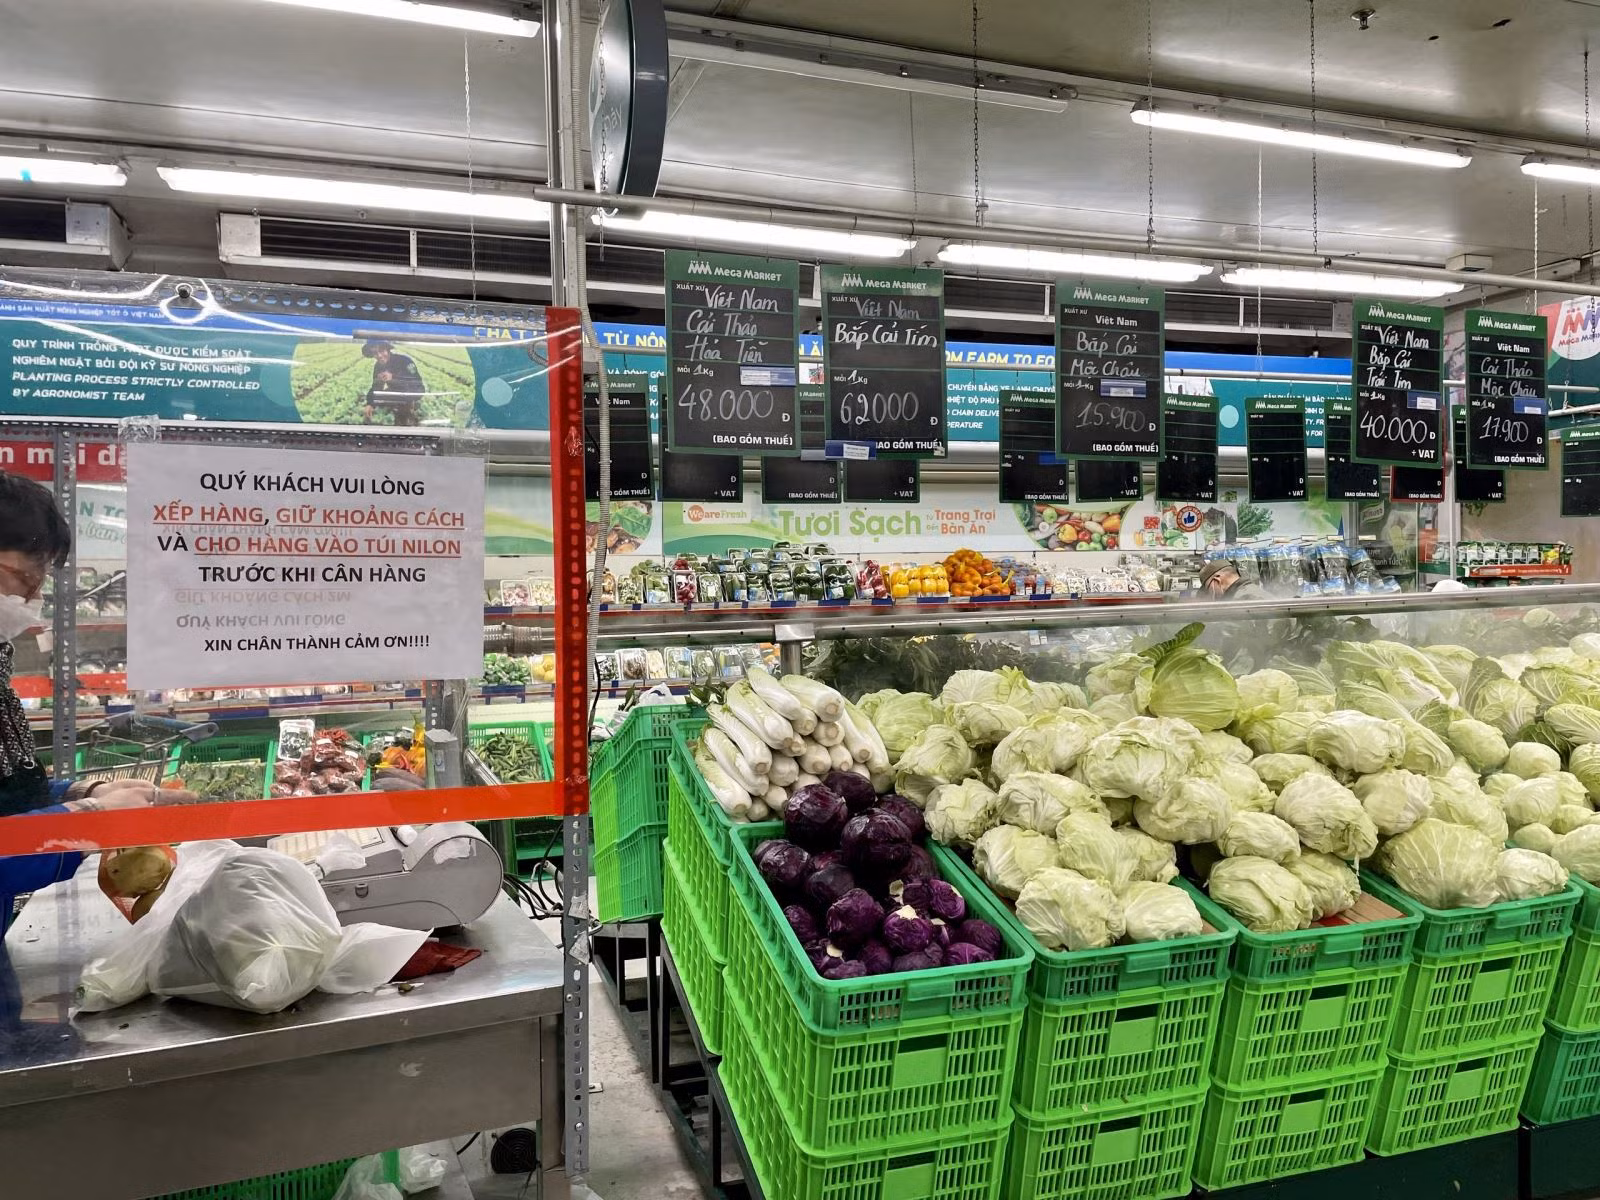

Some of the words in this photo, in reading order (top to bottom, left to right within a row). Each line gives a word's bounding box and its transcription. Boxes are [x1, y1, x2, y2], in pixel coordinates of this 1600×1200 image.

[739, 287, 779, 313] Nam
[1095, 314, 1114, 325] Việt
[1116, 316, 1138, 327] Nam
[12, 338, 37, 350] QUY
[42, 338, 75, 351] TRÌNH
[834, 320, 869, 350] Bắp
[1404, 329, 1429, 349] Nam
[1513, 344, 1530, 353] Nam
[12, 354, 57, 367] NGHIÊM
[966, 351, 1009, 364] FARM
[1013, 353, 1033, 366] TO
[1102, 360, 1141, 378] Châu
[12, 371, 73, 383] PLANTING
[74, 374, 129, 386] PROCESS
[131, 376, 185, 388] STRICTLY
[187, 379, 261, 391] CONTROLLED
[1394, 370, 1411, 390] Tim
[1509, 380, 1538, 398] Châu
[12, 388, 30, 398] BY
[32, 389, 109, 401] AGRONOMIST
[113, 391, 145, 401] TEAM
[678, 384, 774, 421] 48.000
[951, 408, 974, 416] CHAIN
[1360, 410, 1428, 444] 40.000
[1418, 449, 1435, 459] VAT
[200, 471, 247, 491] QUÝ
[253, 472, 324, 493] KHÁCH
[330, 476, 365, 494] VUI
[371, 475, 425, 496] LÒNG
[153, 499, 194, 522] XẾP
[201, 502, 271, 525] HÀNG,
[276, 505, 317, 524] GIỮ
[322, 505, 409, 526] KHOẢNG
[414, 505, 465, 527] CÁCH
[778, 510, 840, 536] Tươi
[849, 510, 922, 543] Sạch
[934, 509, 970, 523] Trang
[973, 509, 996, 523] Trại
[941, 521, 965, 534] Bàn
[969, 520, 986, 534] Ăn
[158, 531, 189, 552] VÀ
[194, 536, 241, 553] CHO
[247, 532, 309, 554] HÀNG
[315, 532, 359, 554] VÀO
[364, 532, 396, 554] TÚI
[402, 538, 462, 555] NILON
[198, 563, 275, 583] TRƯỚC
[281, 566, 316, 582] KHI
[321, 562, 363, 583] CÂN
[369, 563, 426, 583] HÀNG
[204, 638, 232, 652] XIN
[236, 635, 282, 652] CHÂN
[286, 634, 341, 651] THÀNH
[344, 633, 380, 649] CẢM
[384, 634, 430, 649] ƠN!!!!
